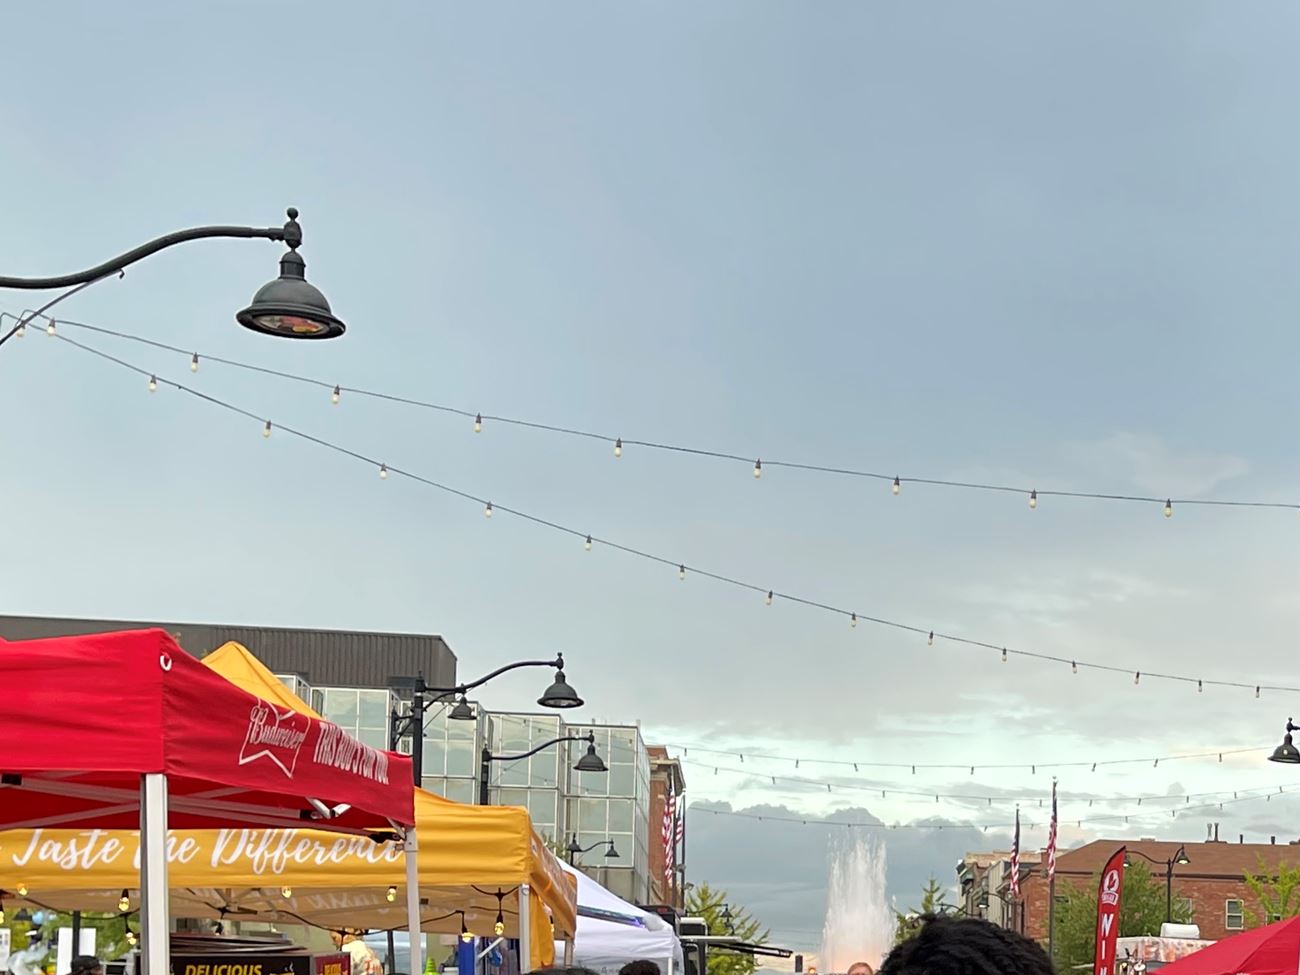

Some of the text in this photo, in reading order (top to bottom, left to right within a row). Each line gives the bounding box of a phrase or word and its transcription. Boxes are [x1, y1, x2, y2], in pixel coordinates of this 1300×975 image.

[250, 705, 305, 750] Budweiser
[12, 828, 124, 871] Taste
[210, 828, 404, 875] Difference
